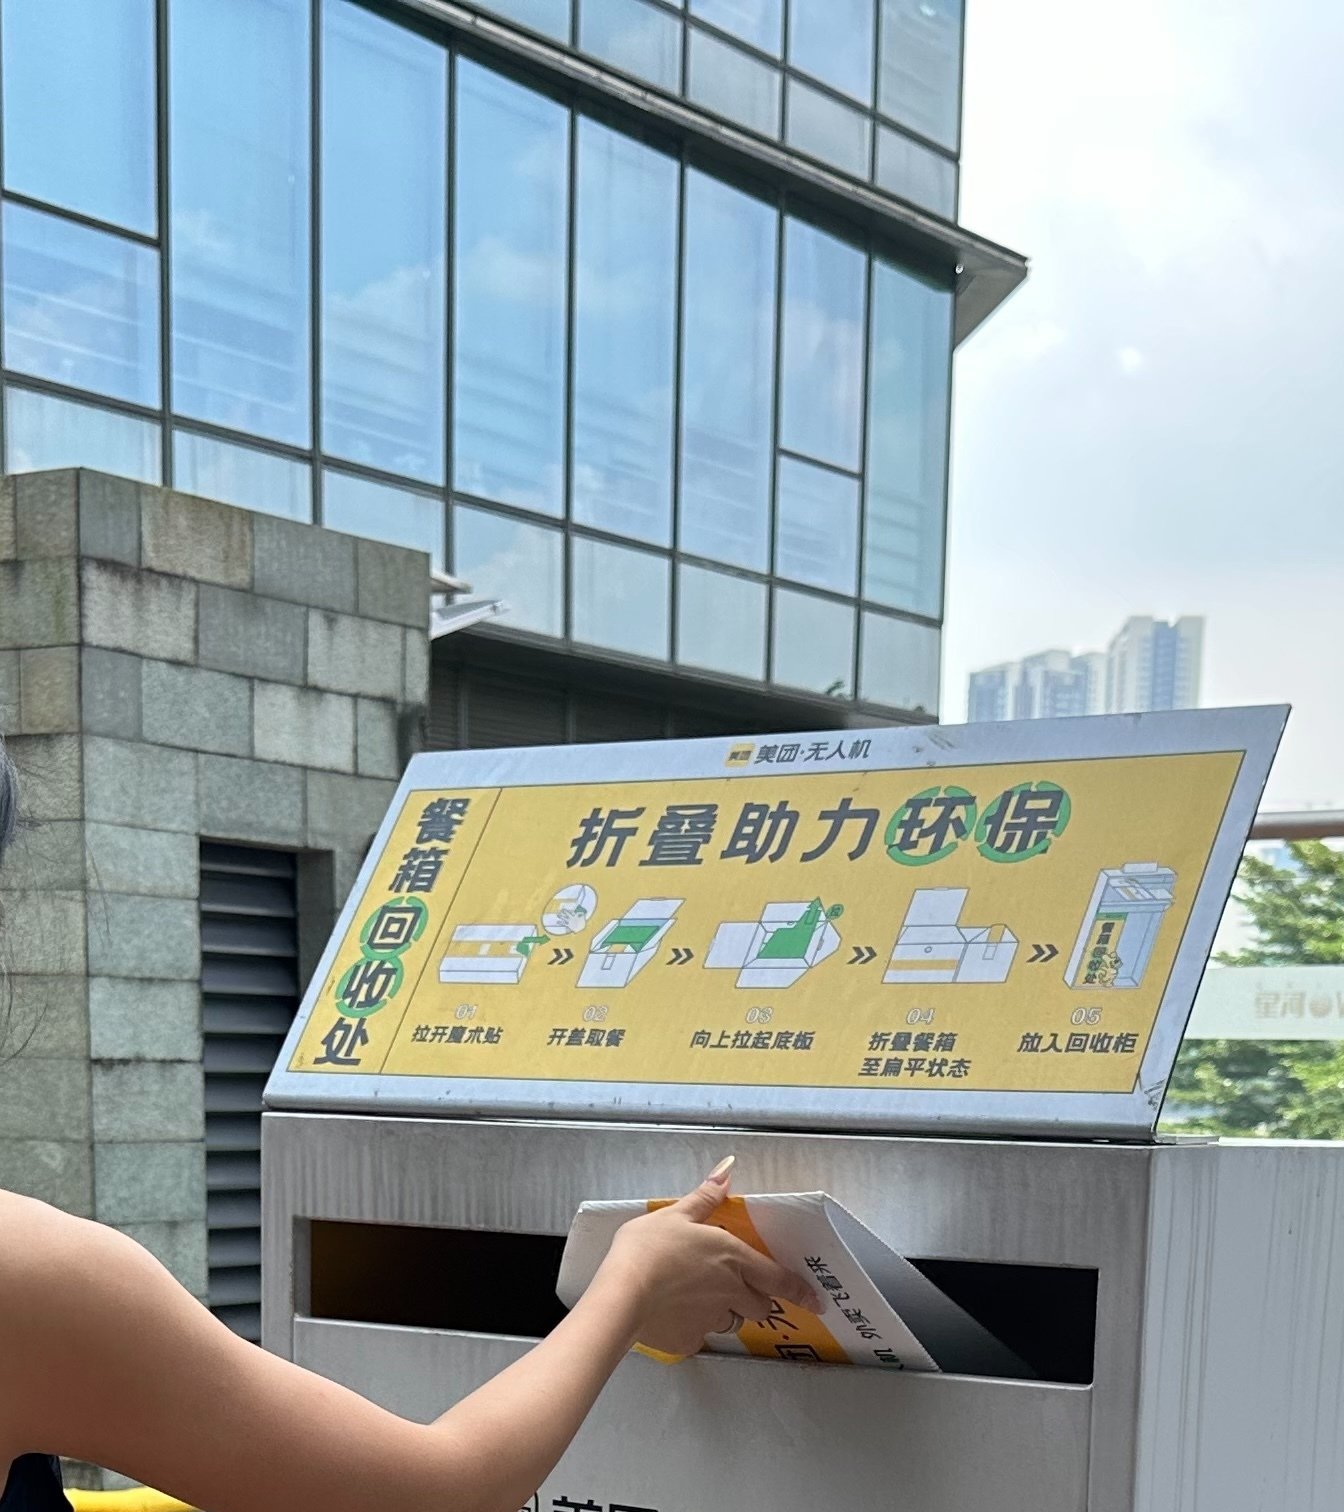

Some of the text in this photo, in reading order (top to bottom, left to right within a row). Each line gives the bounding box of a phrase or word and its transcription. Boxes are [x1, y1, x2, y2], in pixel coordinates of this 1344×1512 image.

[755, 739, 872, 765] 美团·无人机
[566, 788, 1065, 868] 折叠助力环保
[313, 797, 472, 1066] 餐箱回收处
[1071, 1007, 1103, 1025] 05
[689, 1030, 816, 1050] 向上拉起底板
[867, 1031, 958, 1052] 折叠餐箱
[1017, 1033, 1140, 1053] 放入回收柜
[858, 1057, 972, 1078] 至扁平状态
